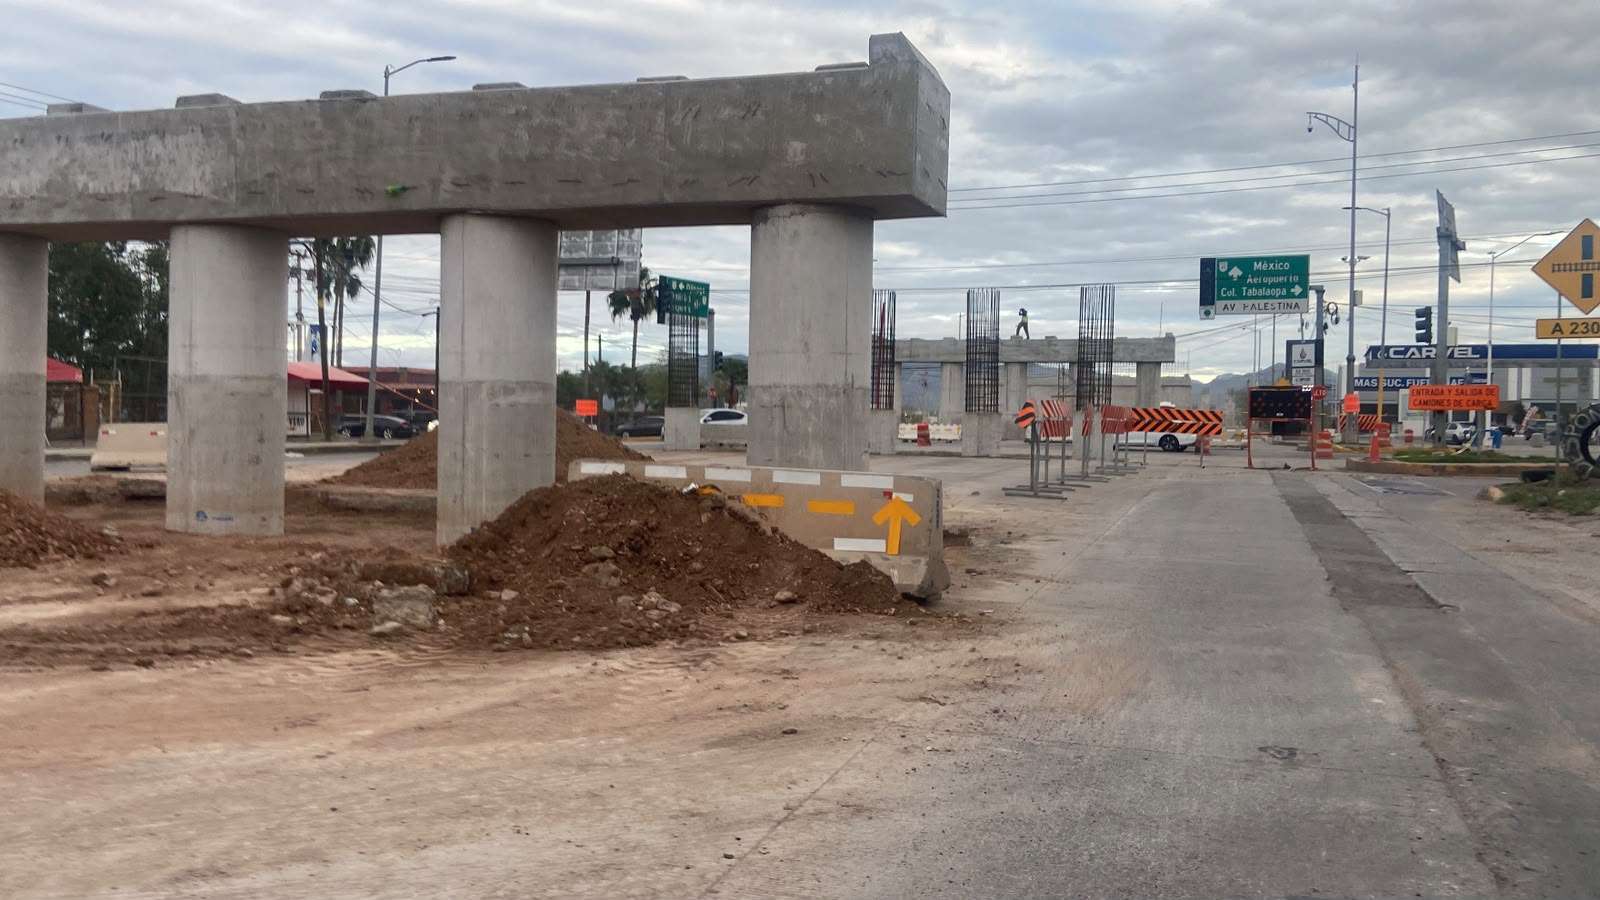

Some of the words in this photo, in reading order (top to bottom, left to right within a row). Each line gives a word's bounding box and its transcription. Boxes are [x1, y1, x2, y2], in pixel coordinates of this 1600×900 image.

[1253, 261, 1290, 271] México
[1246, 274, 1299, 285] Aeropuerto
[1220, 287, 1237, 297] Col.
[1241, 286, 1287, 298] Tabalaopa
[1222, 303, 1236, 312] AV
[1243, 302, 1301, 311] PALESTINA
[1551, 322, 1564, 335] A
[1411, 387, 1443, 396] ENTRADA
[1447, 387, 1452, 396] Y
[1455, 387, 1483, 396] SALIDA
[1486, 387, 1496, 396] DE
[1412, 399, 1452, 407] CAMIONES
[1453, 399, 1464, 407] DE
[1466, 399, 1492, 407] CARGA
